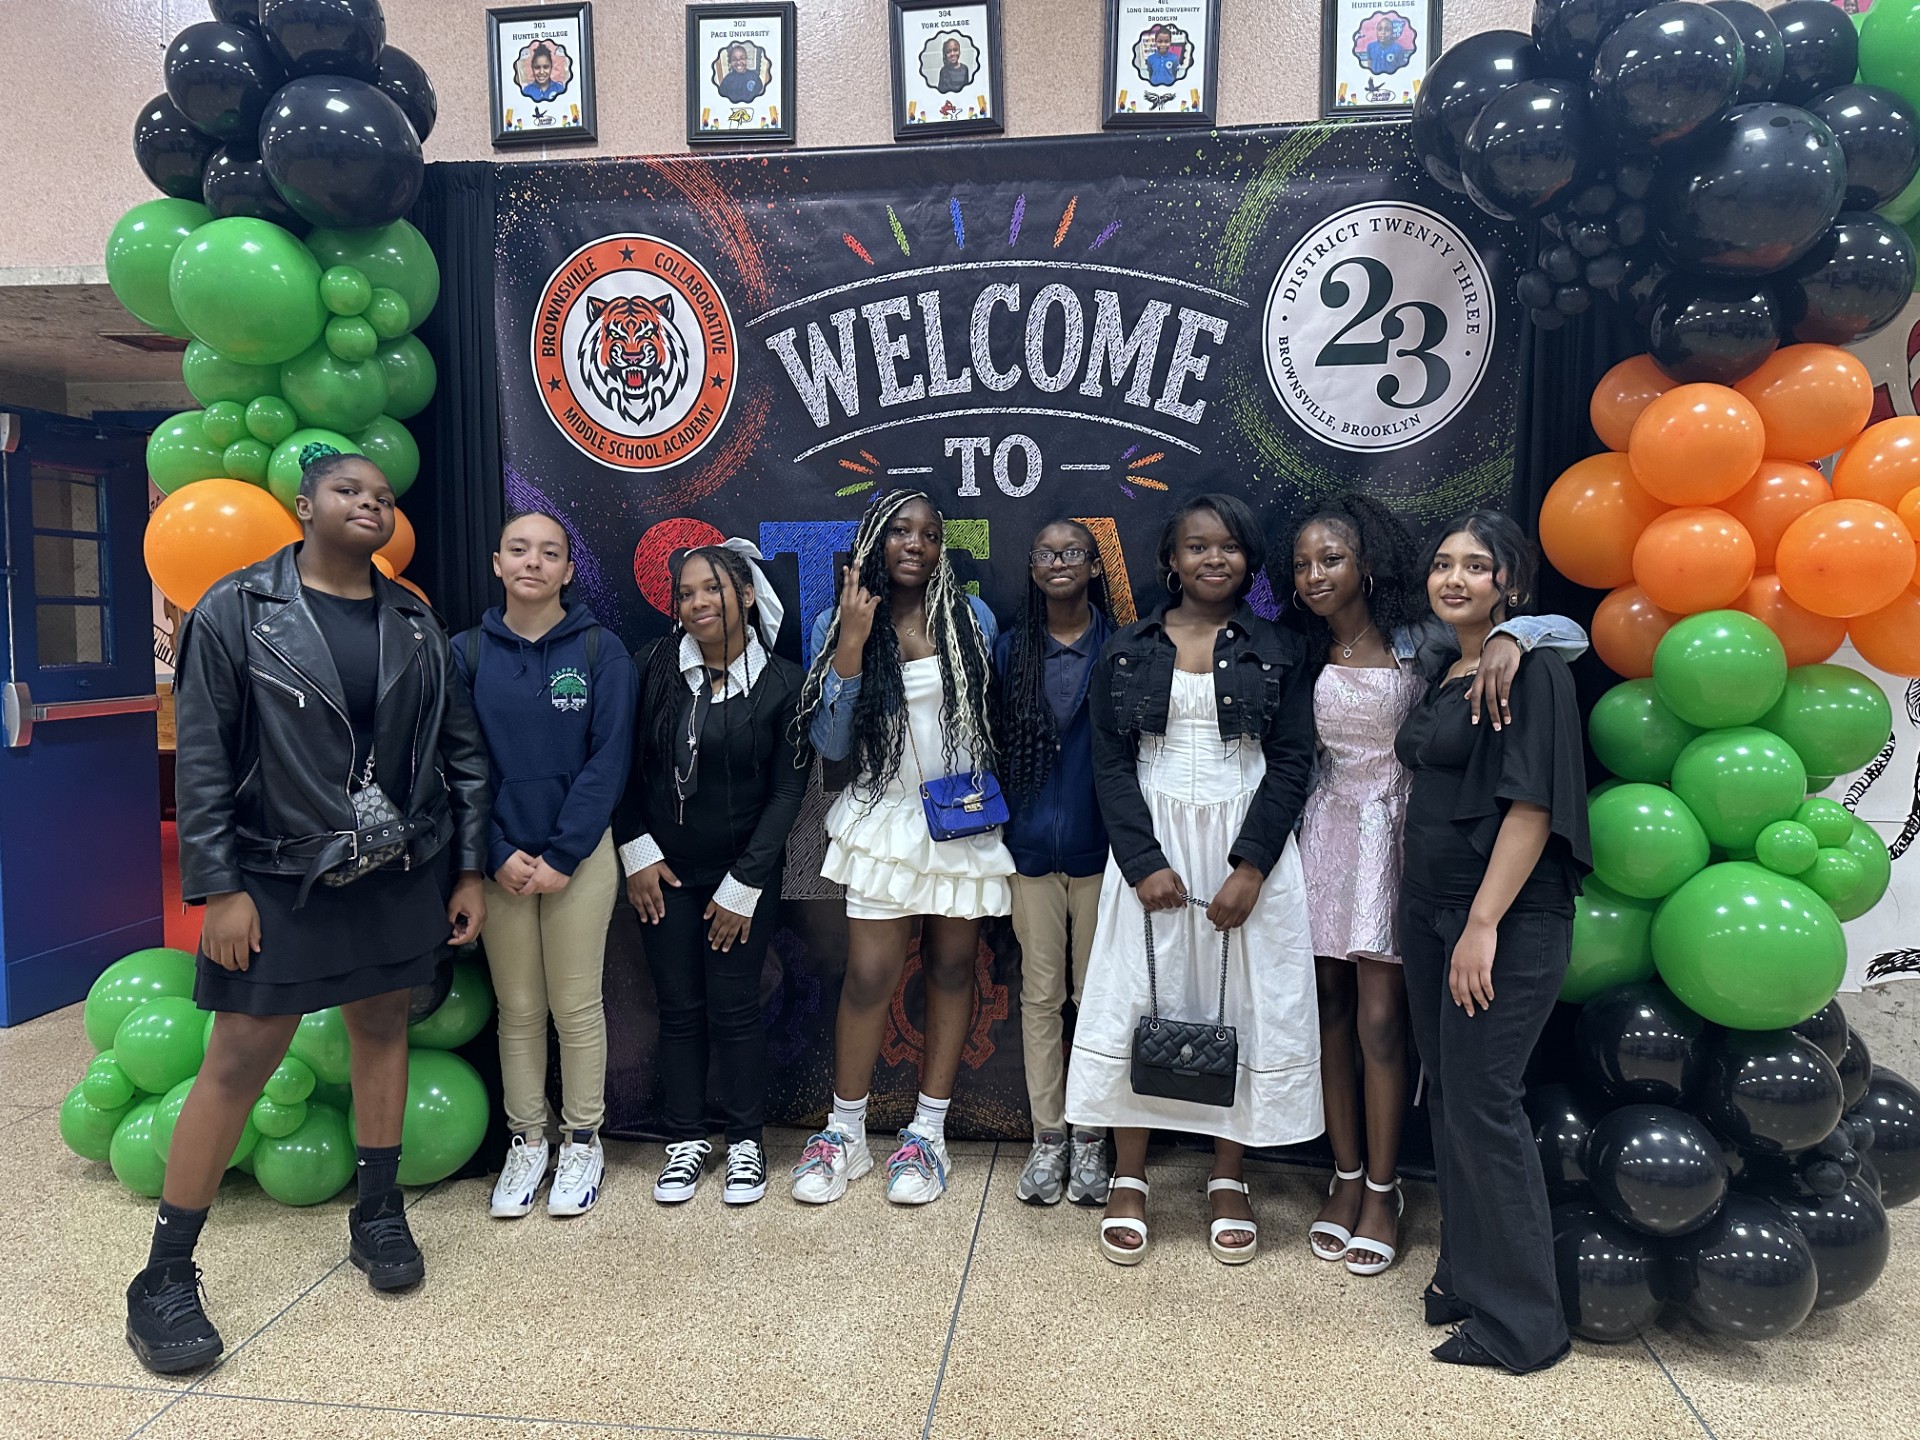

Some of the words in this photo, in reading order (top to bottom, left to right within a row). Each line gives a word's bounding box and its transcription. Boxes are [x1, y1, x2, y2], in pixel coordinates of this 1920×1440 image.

[729, 30, 770, 38] UNIVERSITY
[733, 20, 747, 28] 302
[941, 20, 970, 28] COLLEGE
[1351, 1, 1382, 9] HUNTER
[512, 33, 540, 41] HUNTER
[541, 30, 569, 38] COLLEGE
[541, 256, 598, 357] BROWNSVILLE
[654, 252, 728, 355] COLLABORATIVE
[1283, 222, 1361, 303] DISTRICT
[1369, 217, 1456, 258] TWENTY
[1452, 260, 1481, 335] THREE
[765, 282, 1229, 429] WELCOME
[1314, 256, 1451, 409] 23
[1278, 335, 1337, 431] BROWNSVILLE,
[1340, 412, 1422, 437] BROOKLYN
[562, 406, 605, 451] MIDDLE
[609, 440, 662, 461] SCHOOL
[663, 402, 715, 456] ACADEMY
[944, 433, 1043, 498] TO
[549, 667, 578, 680] KAPPA
